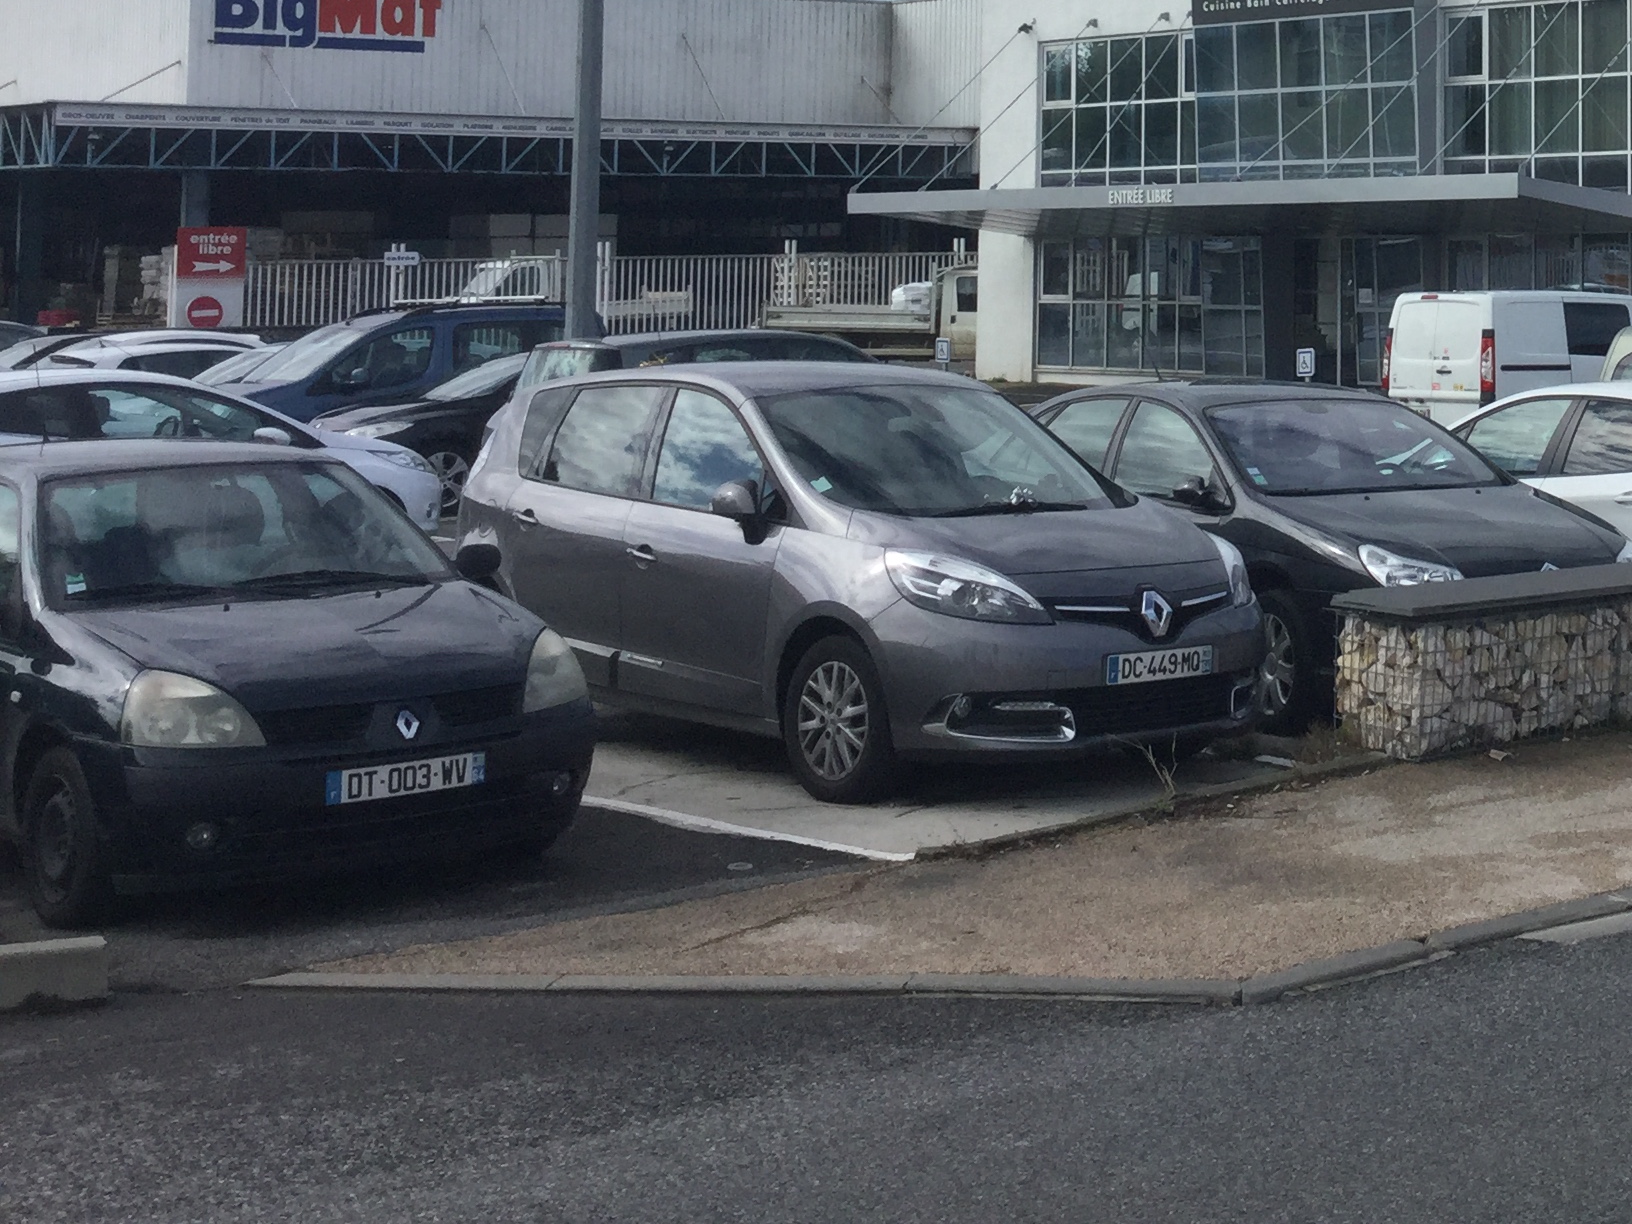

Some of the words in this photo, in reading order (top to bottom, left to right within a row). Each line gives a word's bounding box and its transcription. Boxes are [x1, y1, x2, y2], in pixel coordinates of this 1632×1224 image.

[1202, 0, 1241, 12] Cuisine
[1108, 186, 1145, 205] ENTRÉE
[1146, 188, 1173, 204] LIBRE
[189, 232, 239, 245] entrée
[198, 243, 233, 256] libre
[1121, 650, 1200, 679] DC-449-MQ
[347, 757, 468, 800] DT-003-WV
